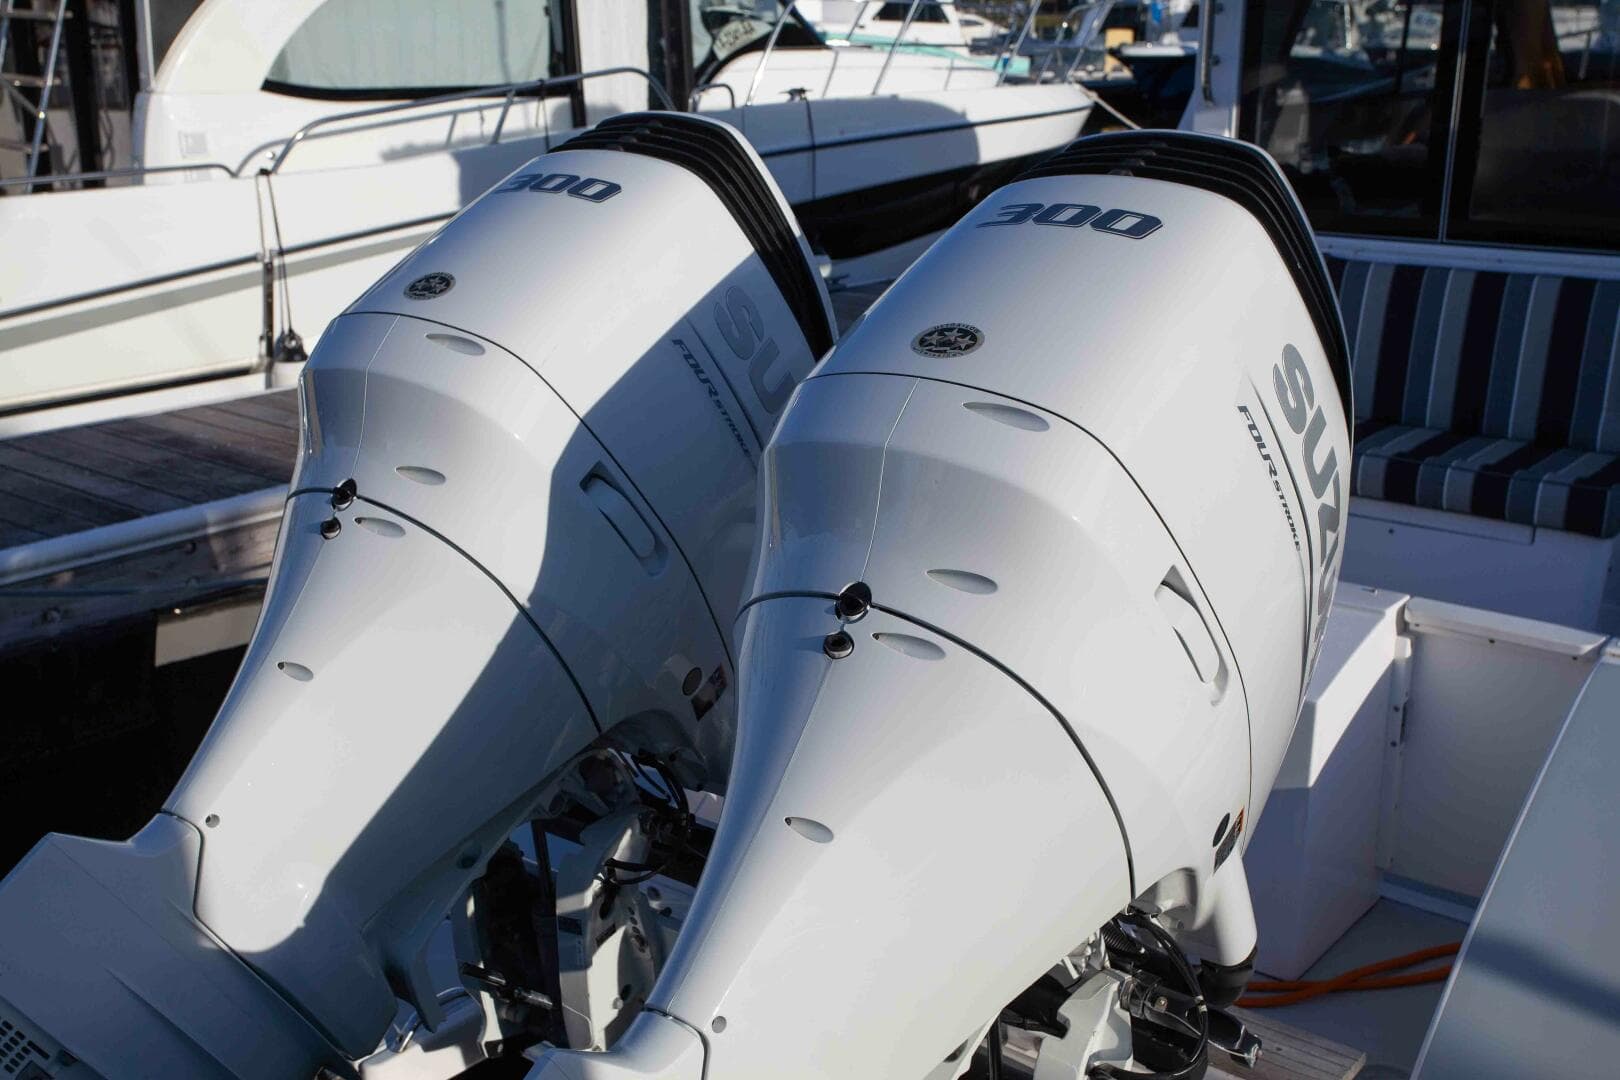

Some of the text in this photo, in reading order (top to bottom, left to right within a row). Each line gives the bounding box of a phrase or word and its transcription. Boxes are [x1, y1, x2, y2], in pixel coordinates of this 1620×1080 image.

[494, 173, 622, 203] 300
[976, 203, 1163, 239] 300
[672, 339, 719, 398] FOUR
[713, 285, 796, 428] SU
[1237, 405, 1301, 551] FOUR STROKE
[1273, 343, 1341, 685] SUZU
